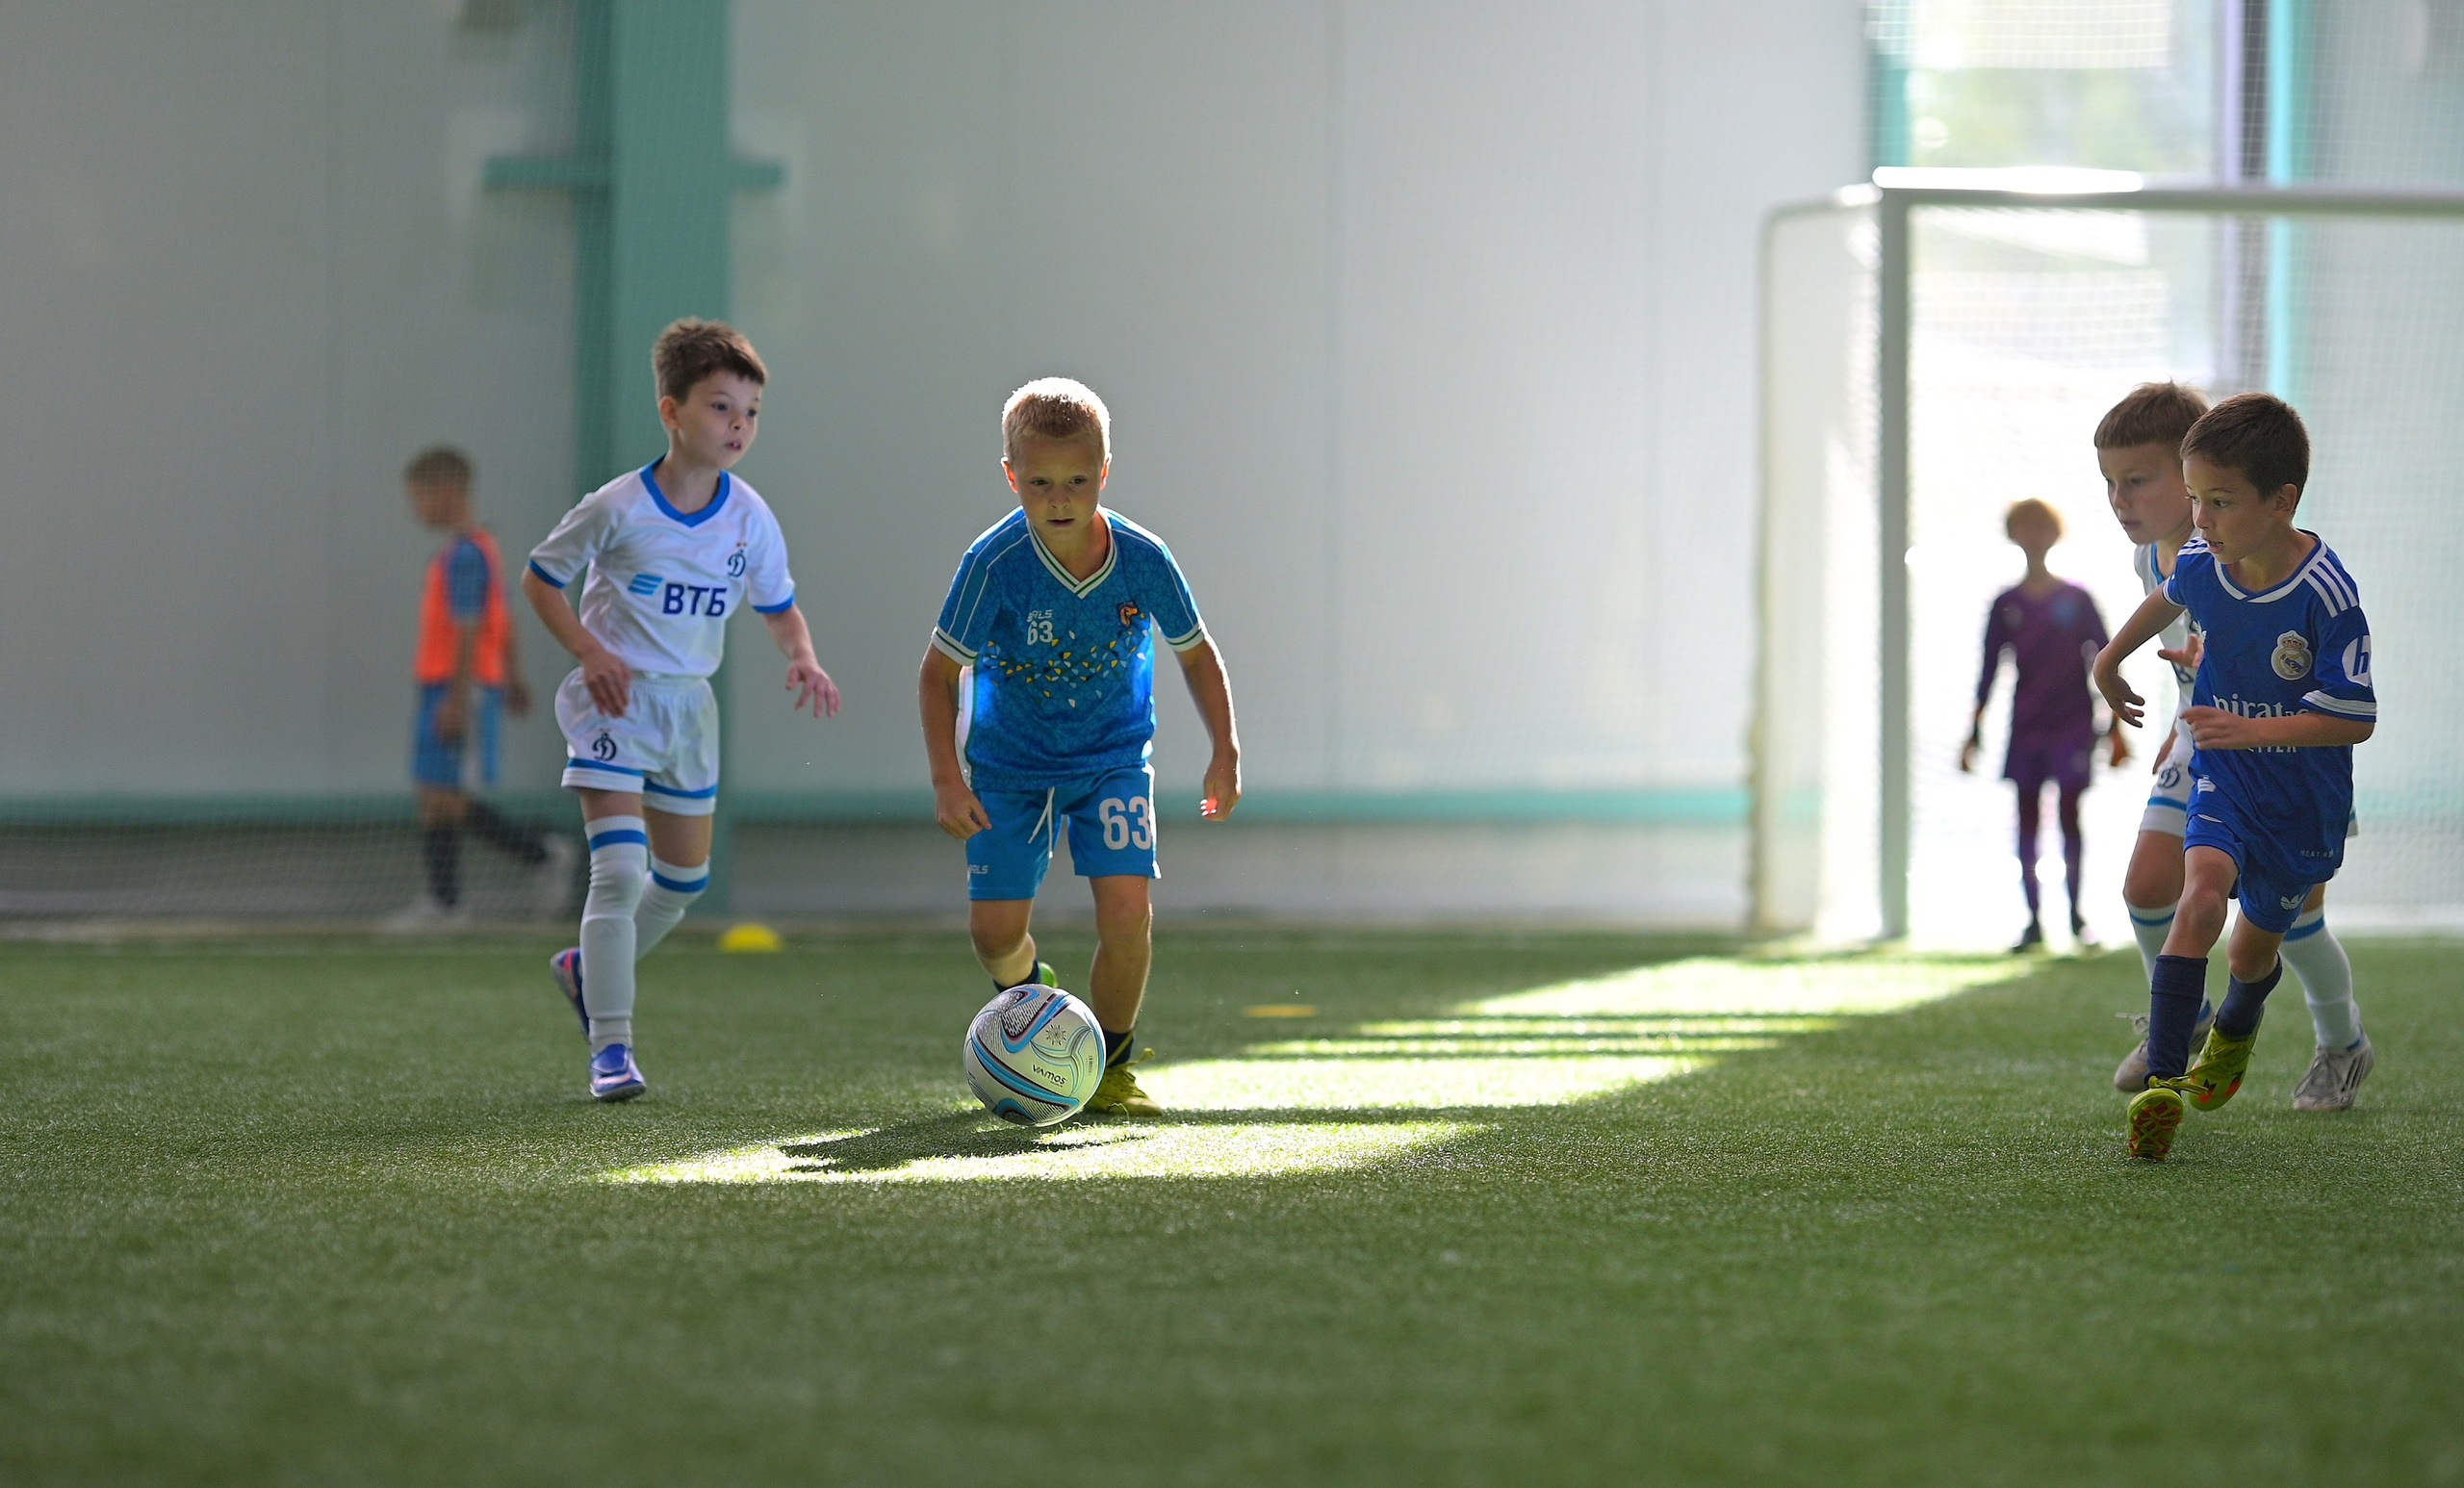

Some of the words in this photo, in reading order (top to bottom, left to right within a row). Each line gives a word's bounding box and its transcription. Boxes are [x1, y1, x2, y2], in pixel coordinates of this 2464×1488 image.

[662, 583, 728, 617] ВТБ
[1027, 621, 1053, 645] 63
[1099, 796, 1151, 850] 63
[1032, 1064, 1067, 1085] VAMOS
